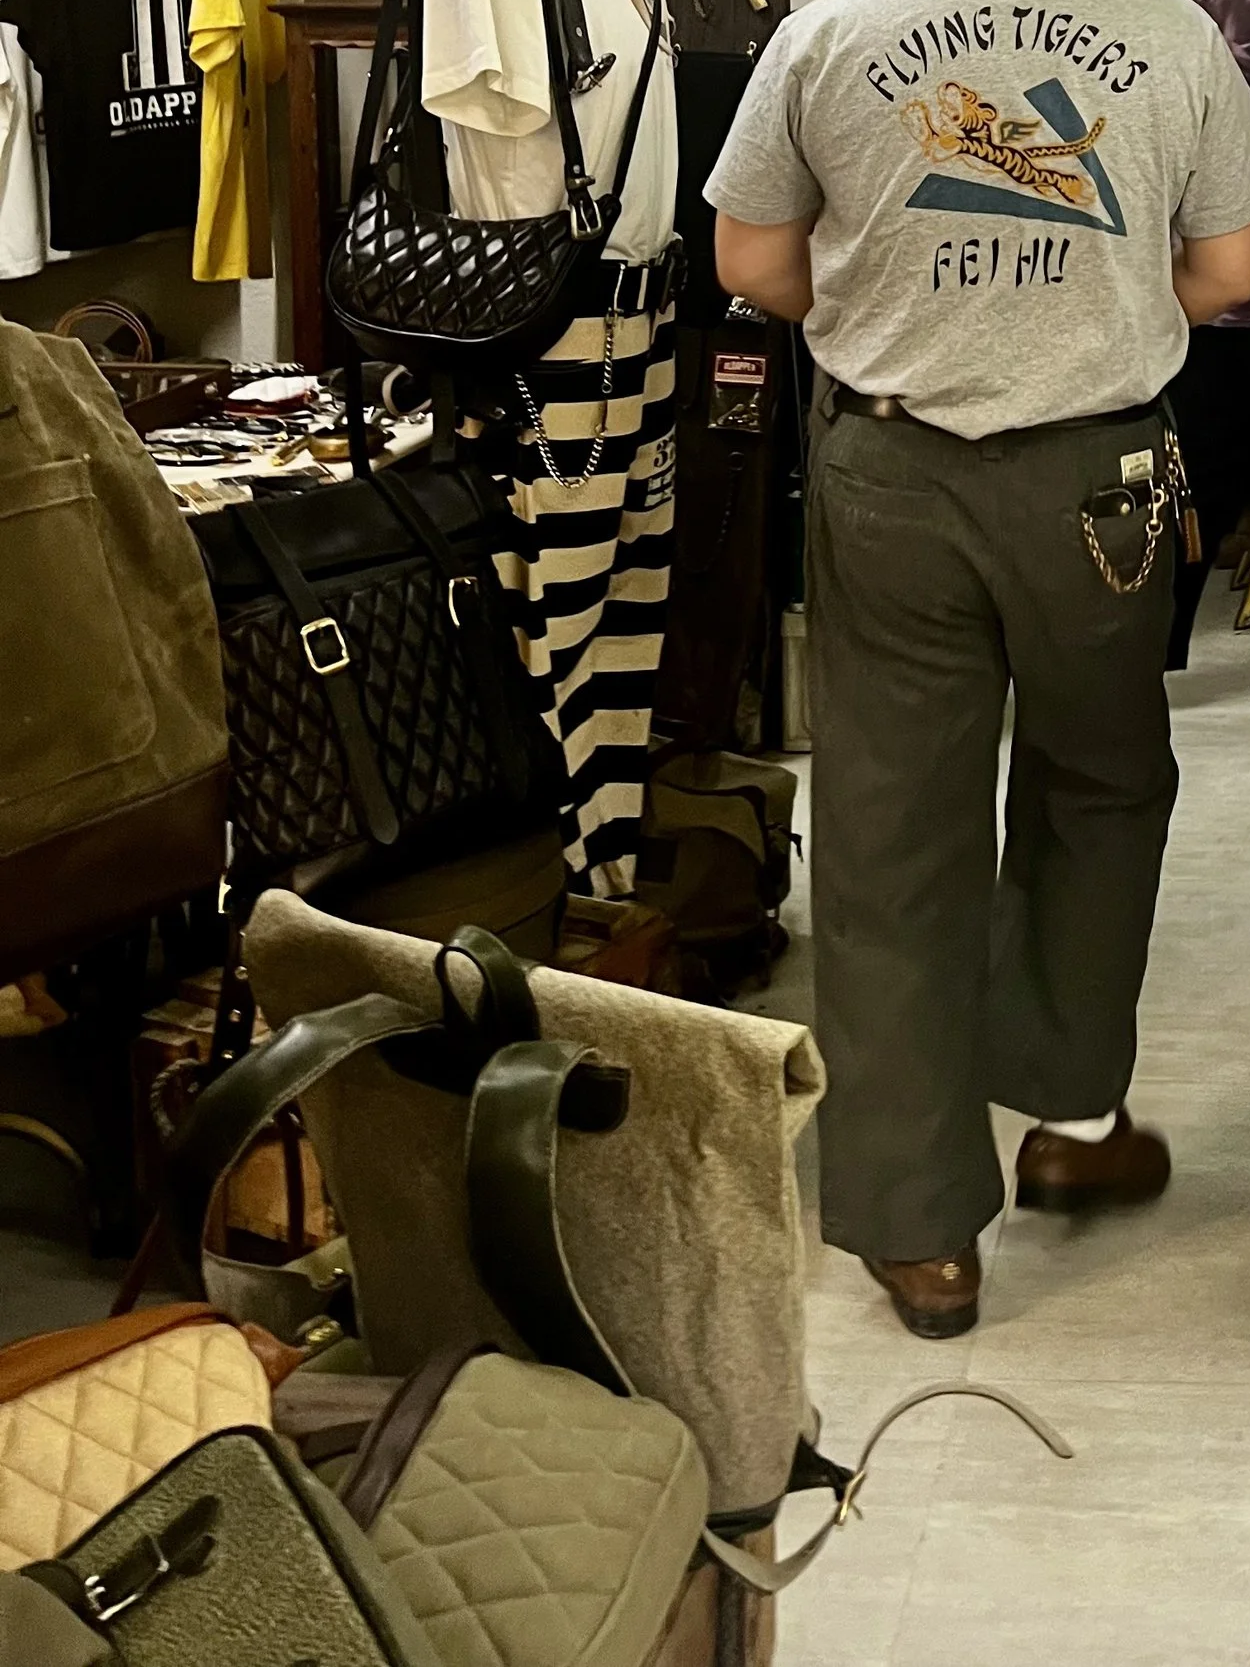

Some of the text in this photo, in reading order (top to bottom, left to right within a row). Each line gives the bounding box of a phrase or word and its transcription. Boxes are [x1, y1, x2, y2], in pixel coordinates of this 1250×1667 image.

[865, 5, 1149, 103] FLYING TIGERS
[109, 90, 197, 127] OLDAPP
[932, 236, 1071, 293] FEI HU
